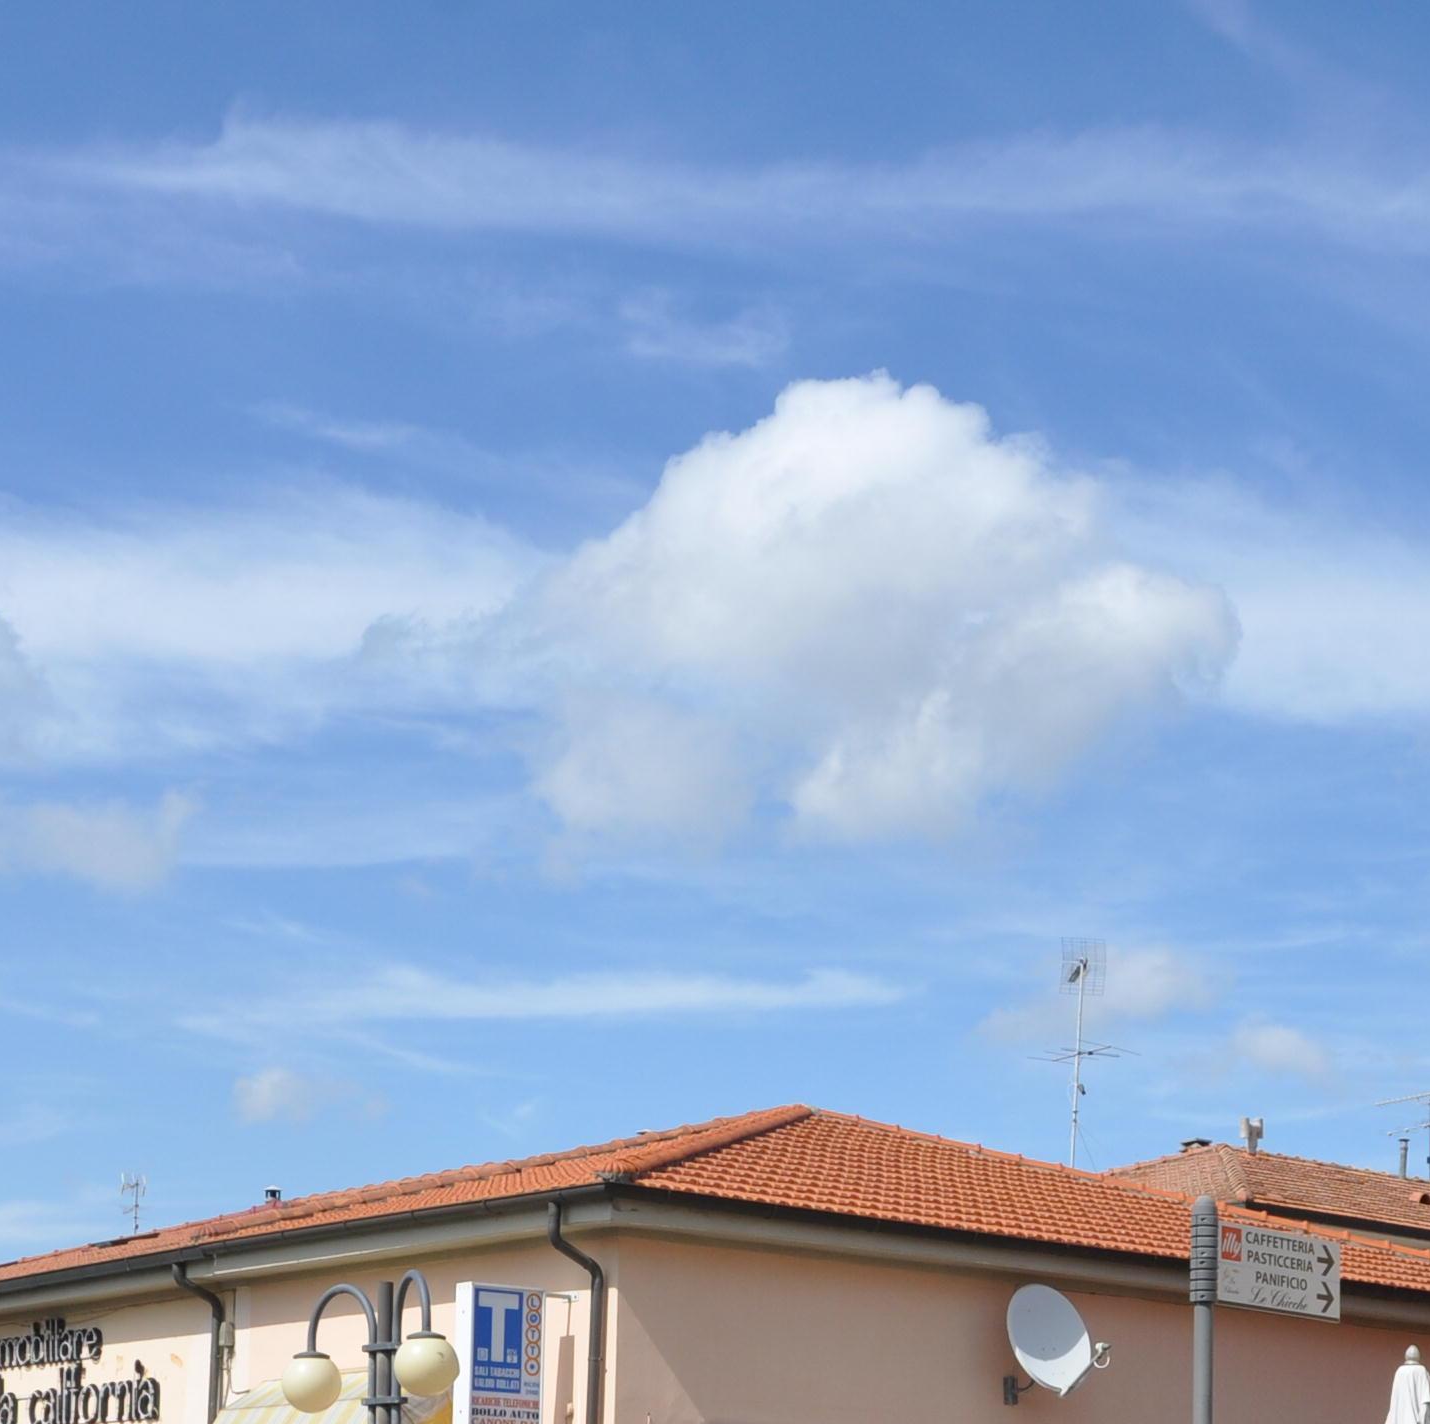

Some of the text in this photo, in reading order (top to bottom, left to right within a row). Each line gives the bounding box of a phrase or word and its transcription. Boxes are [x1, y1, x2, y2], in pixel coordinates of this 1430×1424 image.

[1223, 1232, 1241, 1258] illy
[1245, 1231, 1315, 1255] CAFFETTERIA
[1247, 1250, 1314, 1273] PASTICCERIA
[1255, 1271, 1308, 1291] PANIFICIO
[471, 1407, 539, 1420] BOLLO AUTO
